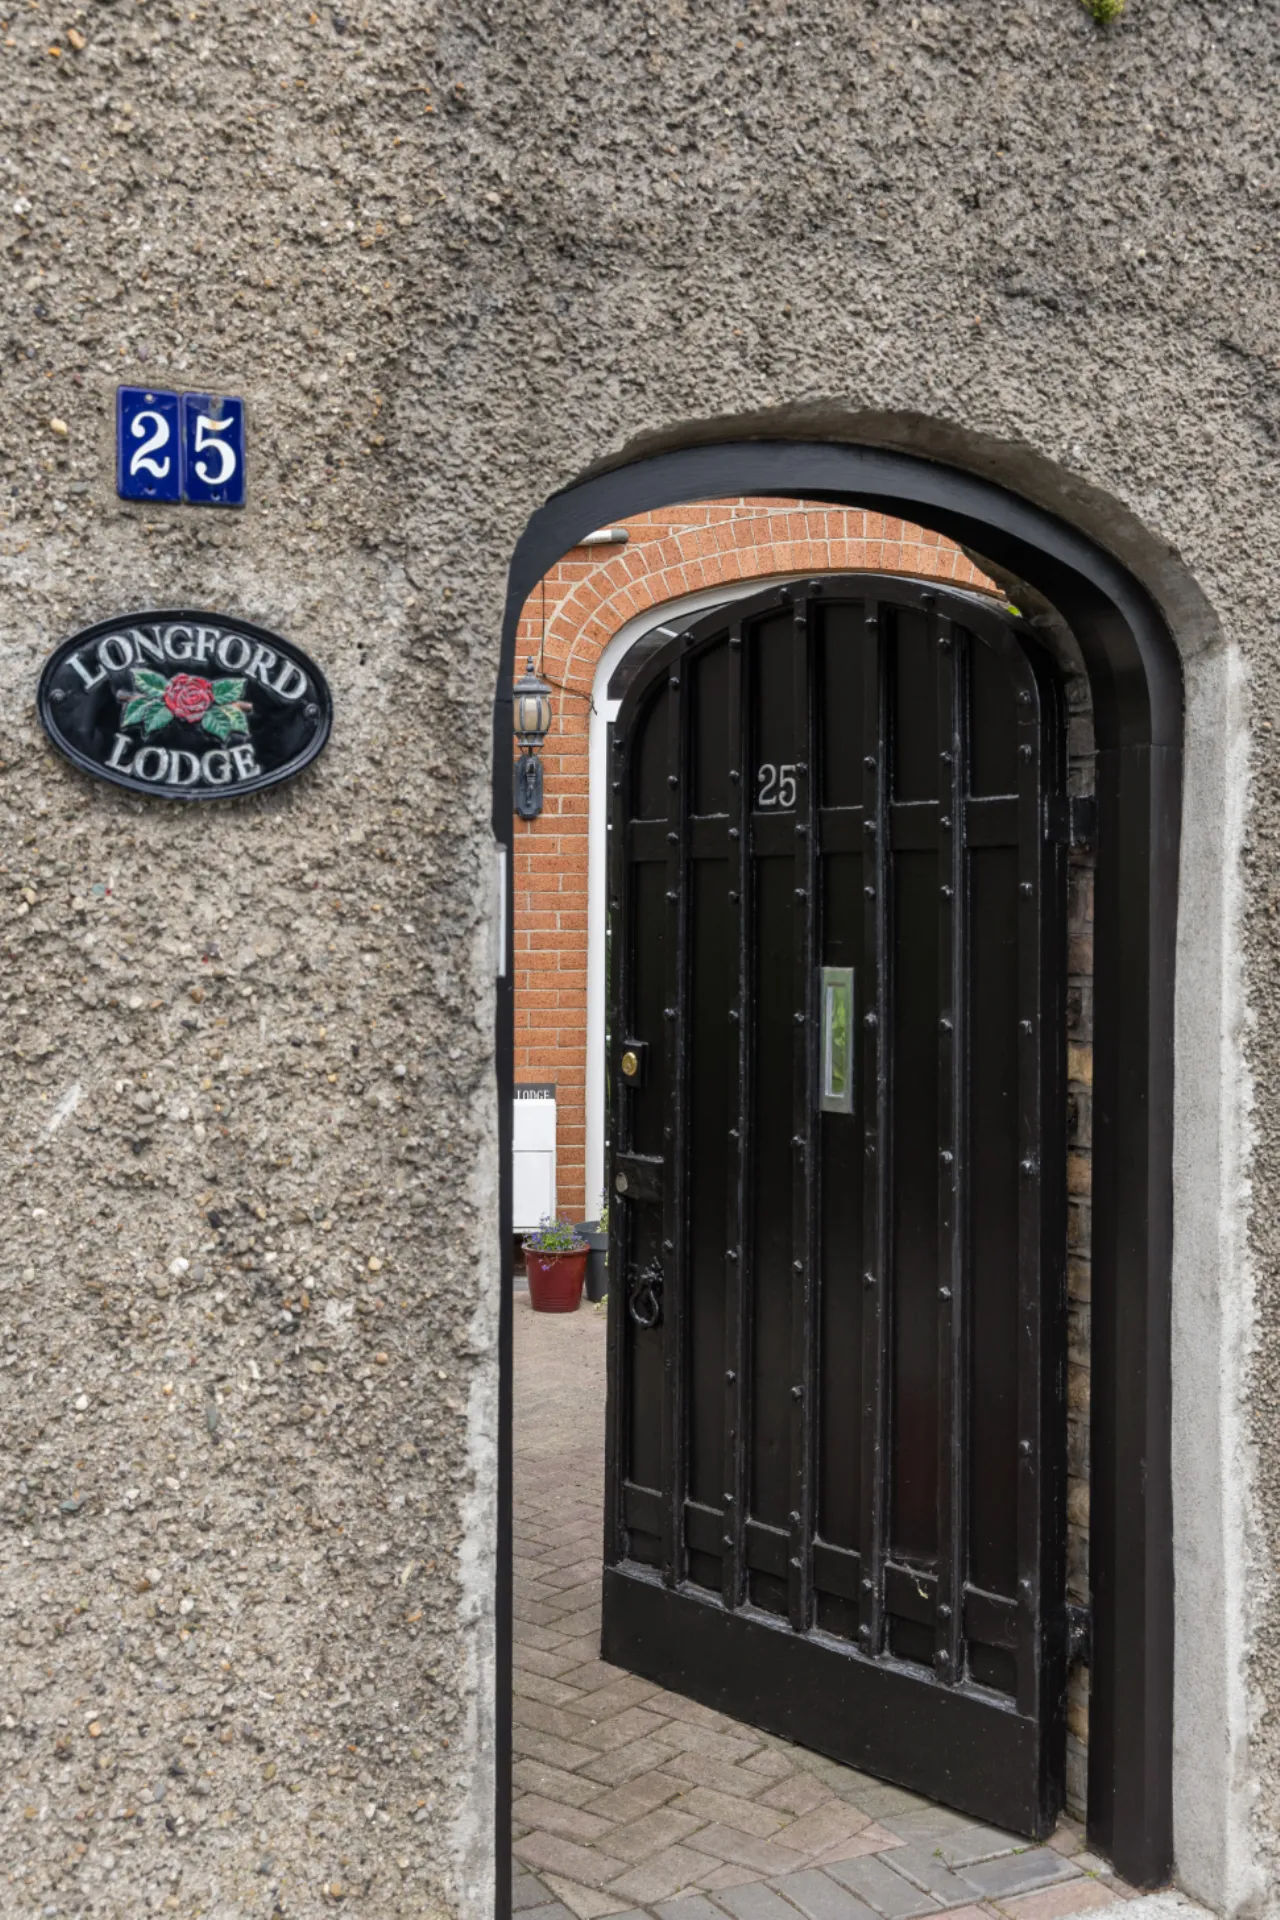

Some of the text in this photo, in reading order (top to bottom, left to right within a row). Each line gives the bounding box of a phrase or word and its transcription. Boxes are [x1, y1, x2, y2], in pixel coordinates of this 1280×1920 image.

[129, 411, 237, 485] 25
[66, 625, 308, 700] LONGFORD
[105, 732, 261, 786] LODGE
[758, 763, 796, 807] 25
[516, 1089, 550, 1100] LODGE
